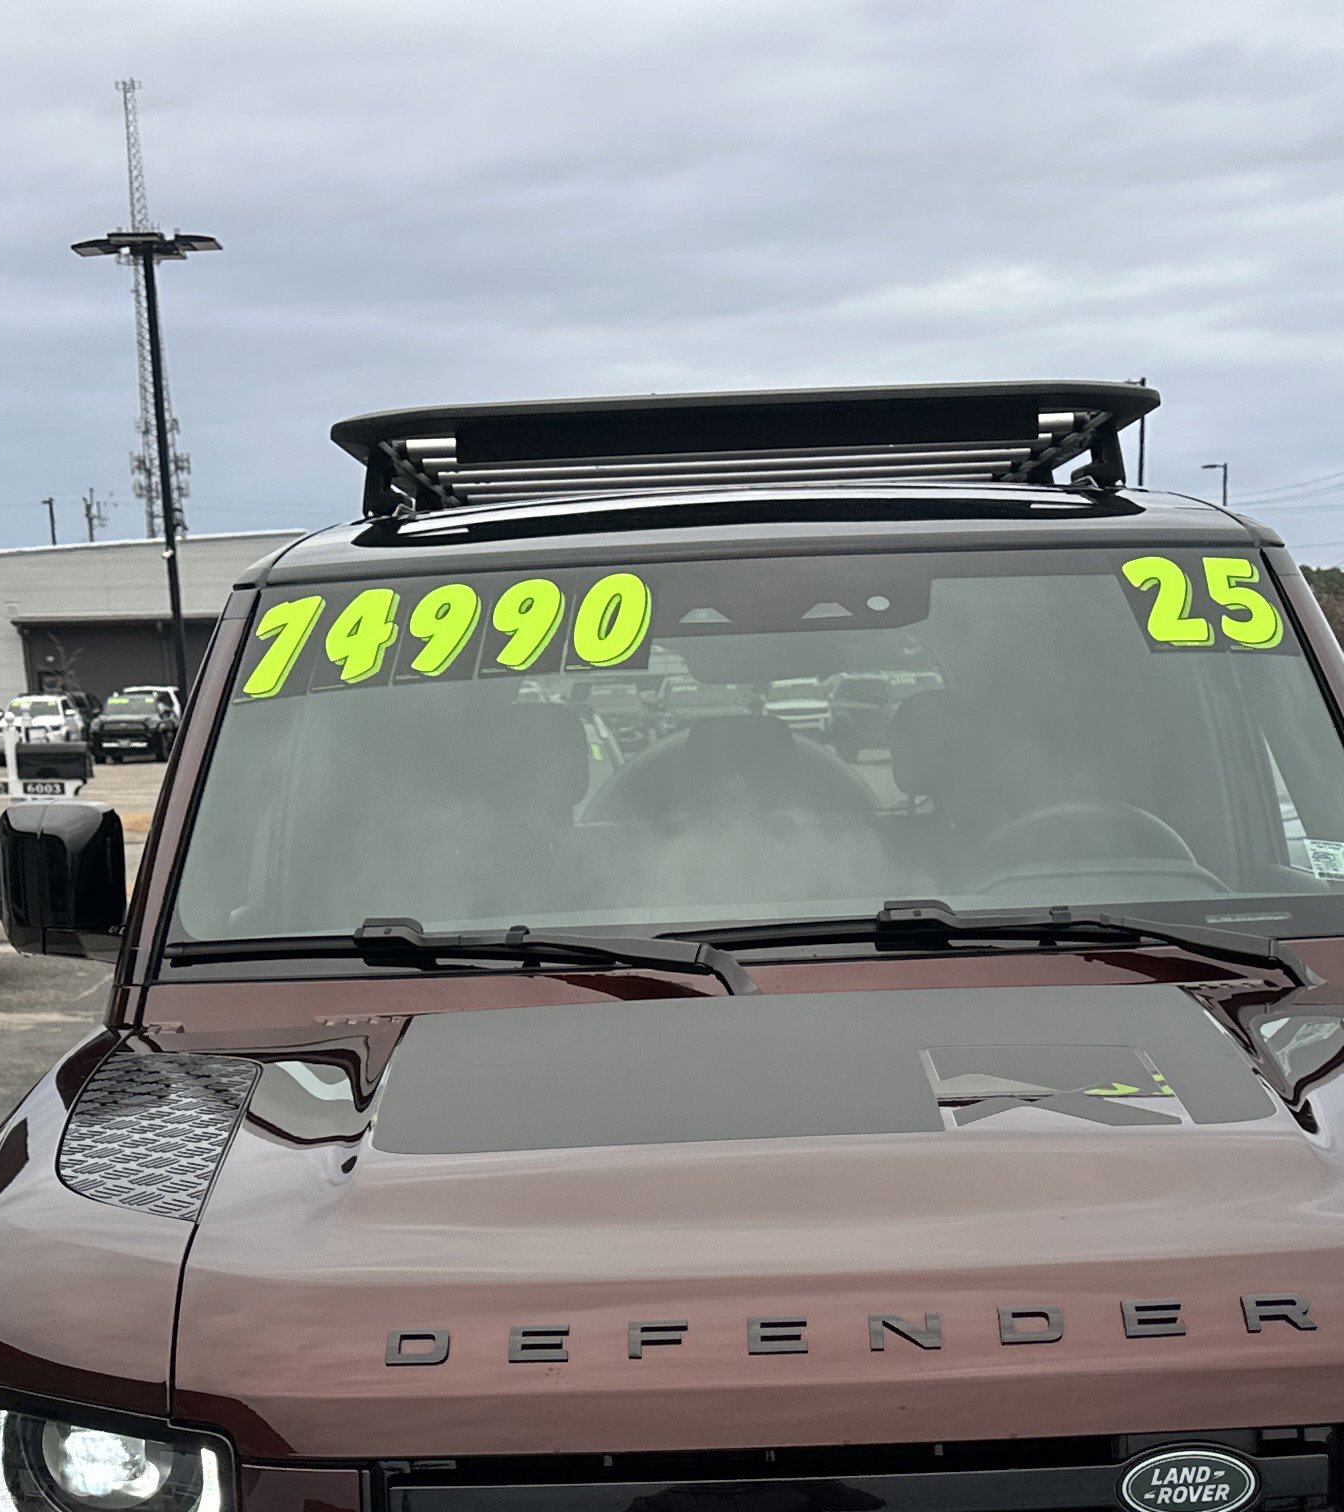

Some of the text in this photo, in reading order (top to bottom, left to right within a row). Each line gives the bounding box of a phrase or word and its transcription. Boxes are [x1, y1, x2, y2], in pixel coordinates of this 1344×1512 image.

[243, 573, 653, 698] 74990
[1122, 556, 1284, 649] 25
[385, 1293, 1317, 1366] DEFENDER
[1151, 1466, 1210, 1486] LAND
[1156, 1484, 1230, 1504] ROVER
